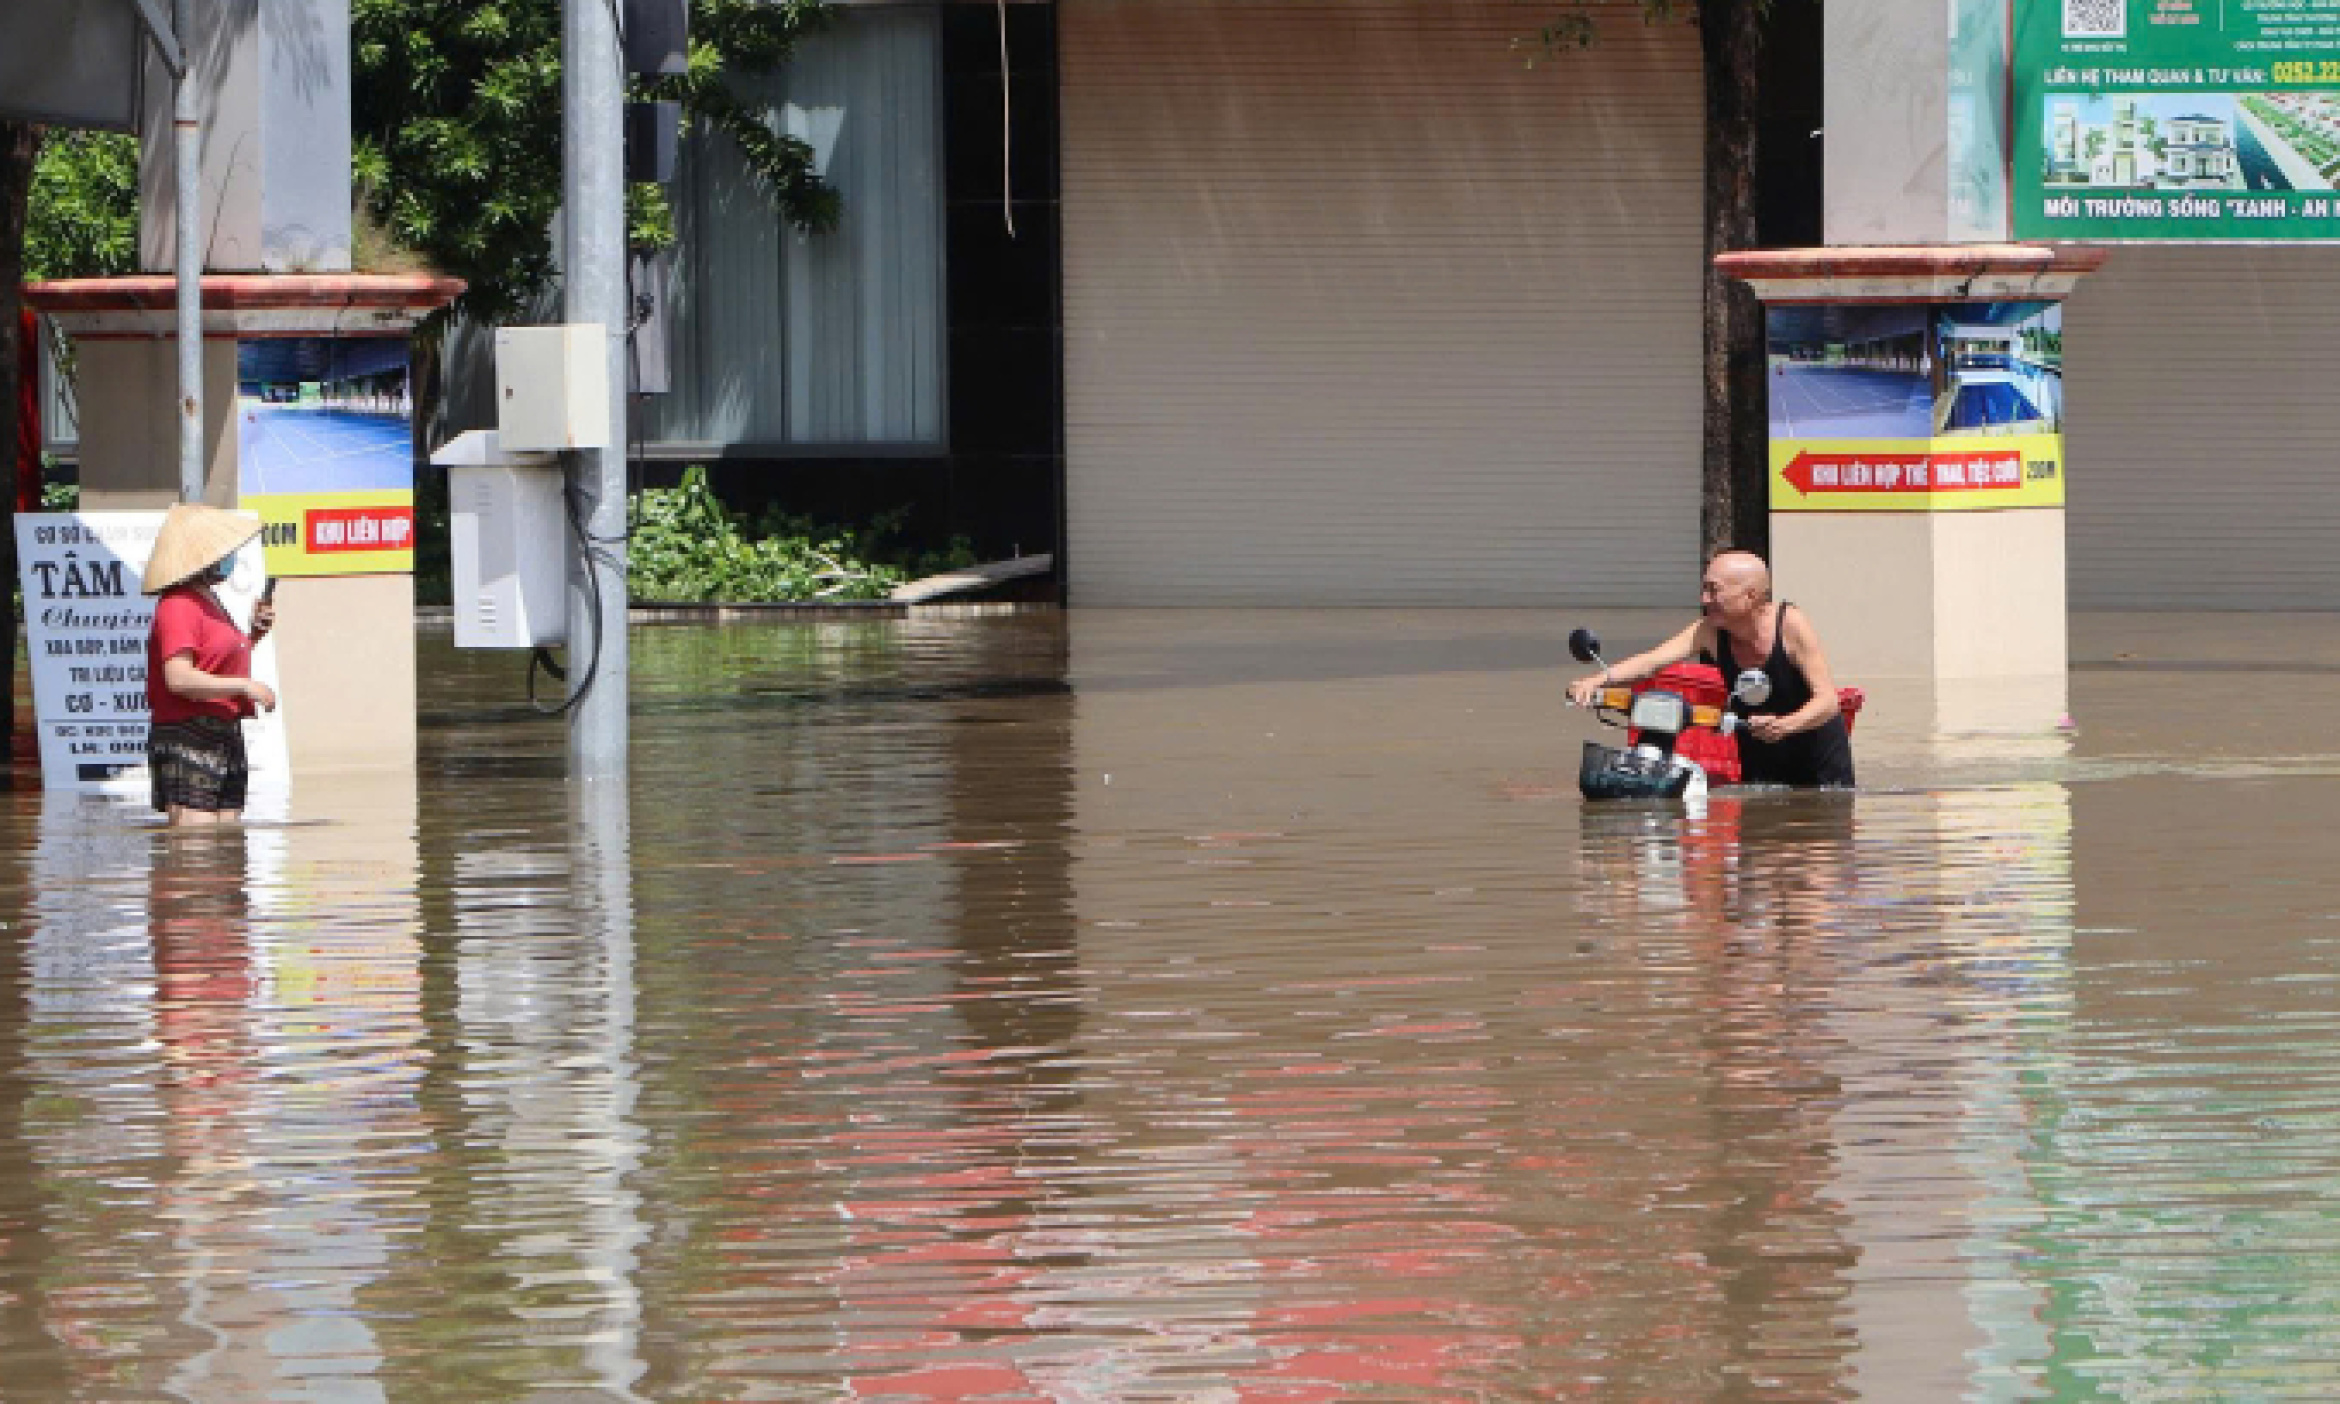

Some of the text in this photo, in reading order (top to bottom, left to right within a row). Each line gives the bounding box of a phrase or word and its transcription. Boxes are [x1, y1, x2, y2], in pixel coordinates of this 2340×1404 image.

[2044, 66, 2076, 83] LIÊN
[2104, 68, 2145, 83] THAM
[2148, 68, 2190, 83] QUAN
[2043, 193, 2079, 217] MÔI
[2084, 193, 2162, 217] TRƯỜNG
[2168, 191, 2220, 217] SỐNG
[315, 521, 345, 545] KHU
[347, 515, 379, 541] LIÊN
[31, 551, 126, 598] TÂM
